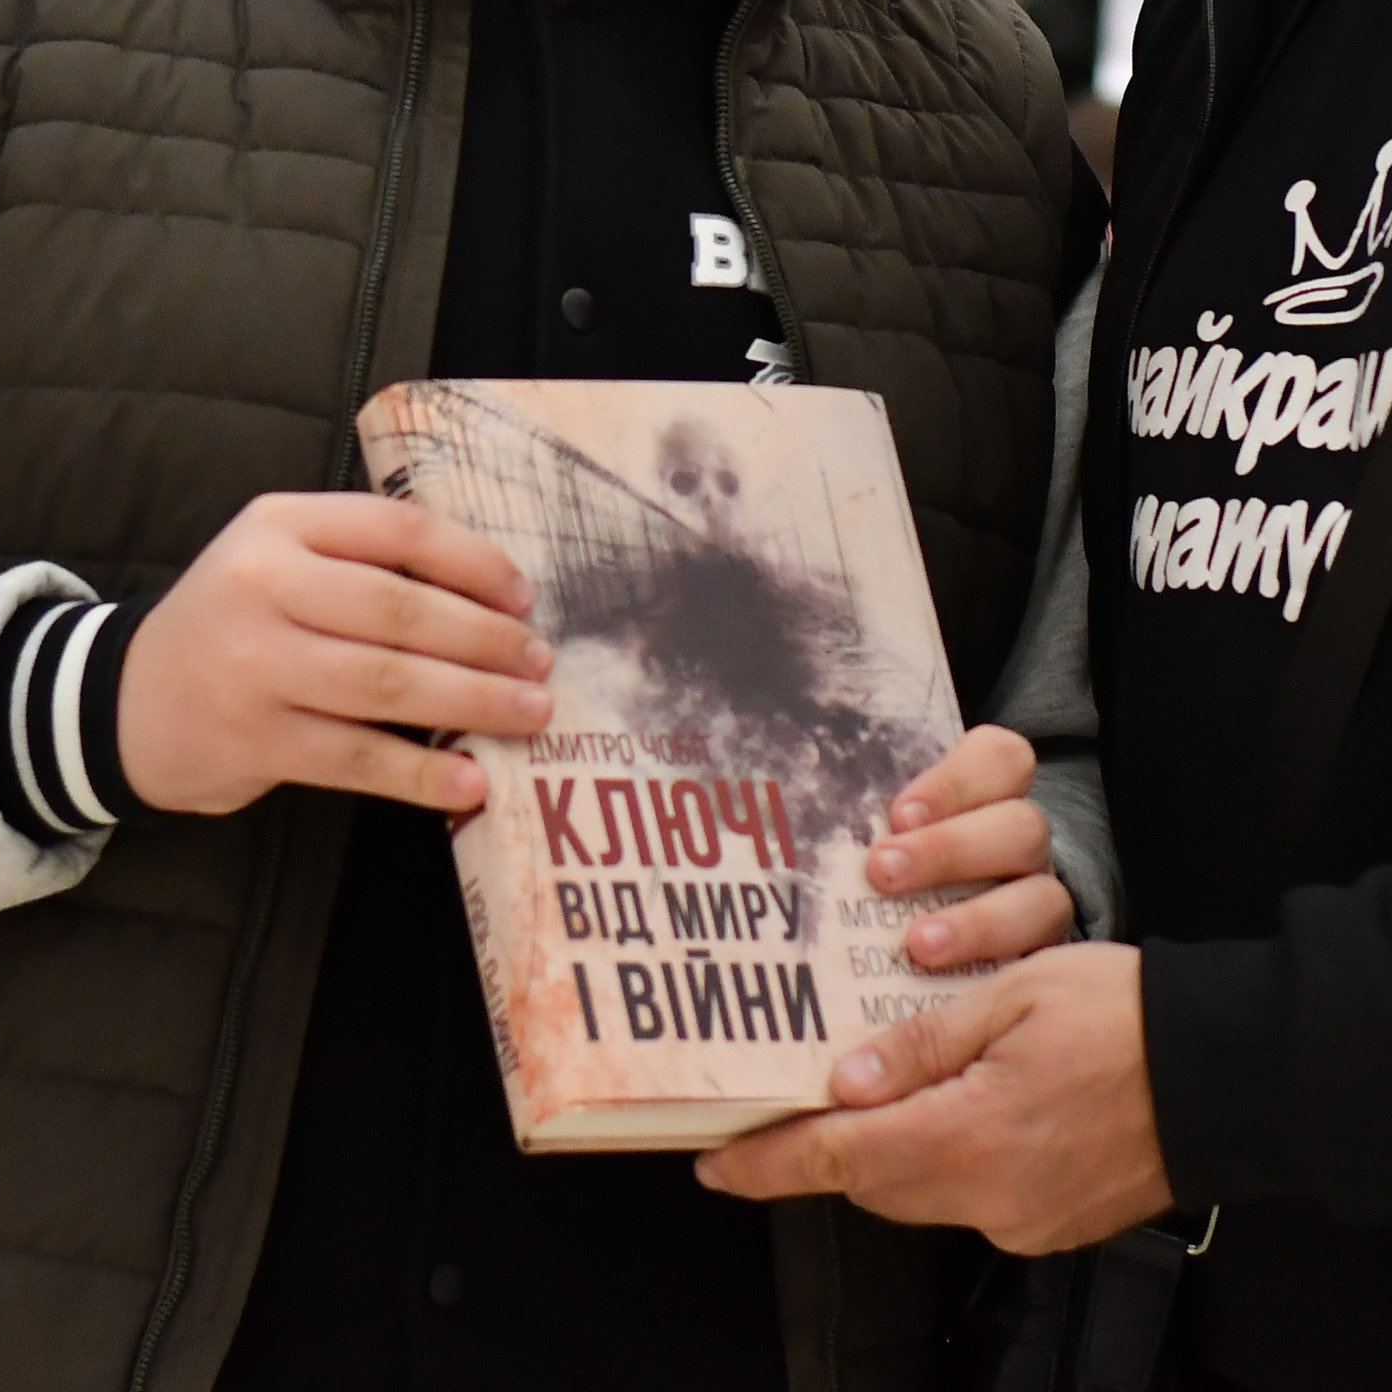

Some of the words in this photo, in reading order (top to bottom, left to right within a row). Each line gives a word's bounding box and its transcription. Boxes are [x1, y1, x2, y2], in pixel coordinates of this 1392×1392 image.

[528, 731, 636, 765] ДМИТРО
[534, 778, 798, 869] КЛЮЧІ
[555, 882, 655, 946] ВІД
[663, 882, 799, 941] МИРУ
[572, 962, 599, 1041] І
[616, 948, 827, 1041] ВІЙНИ
